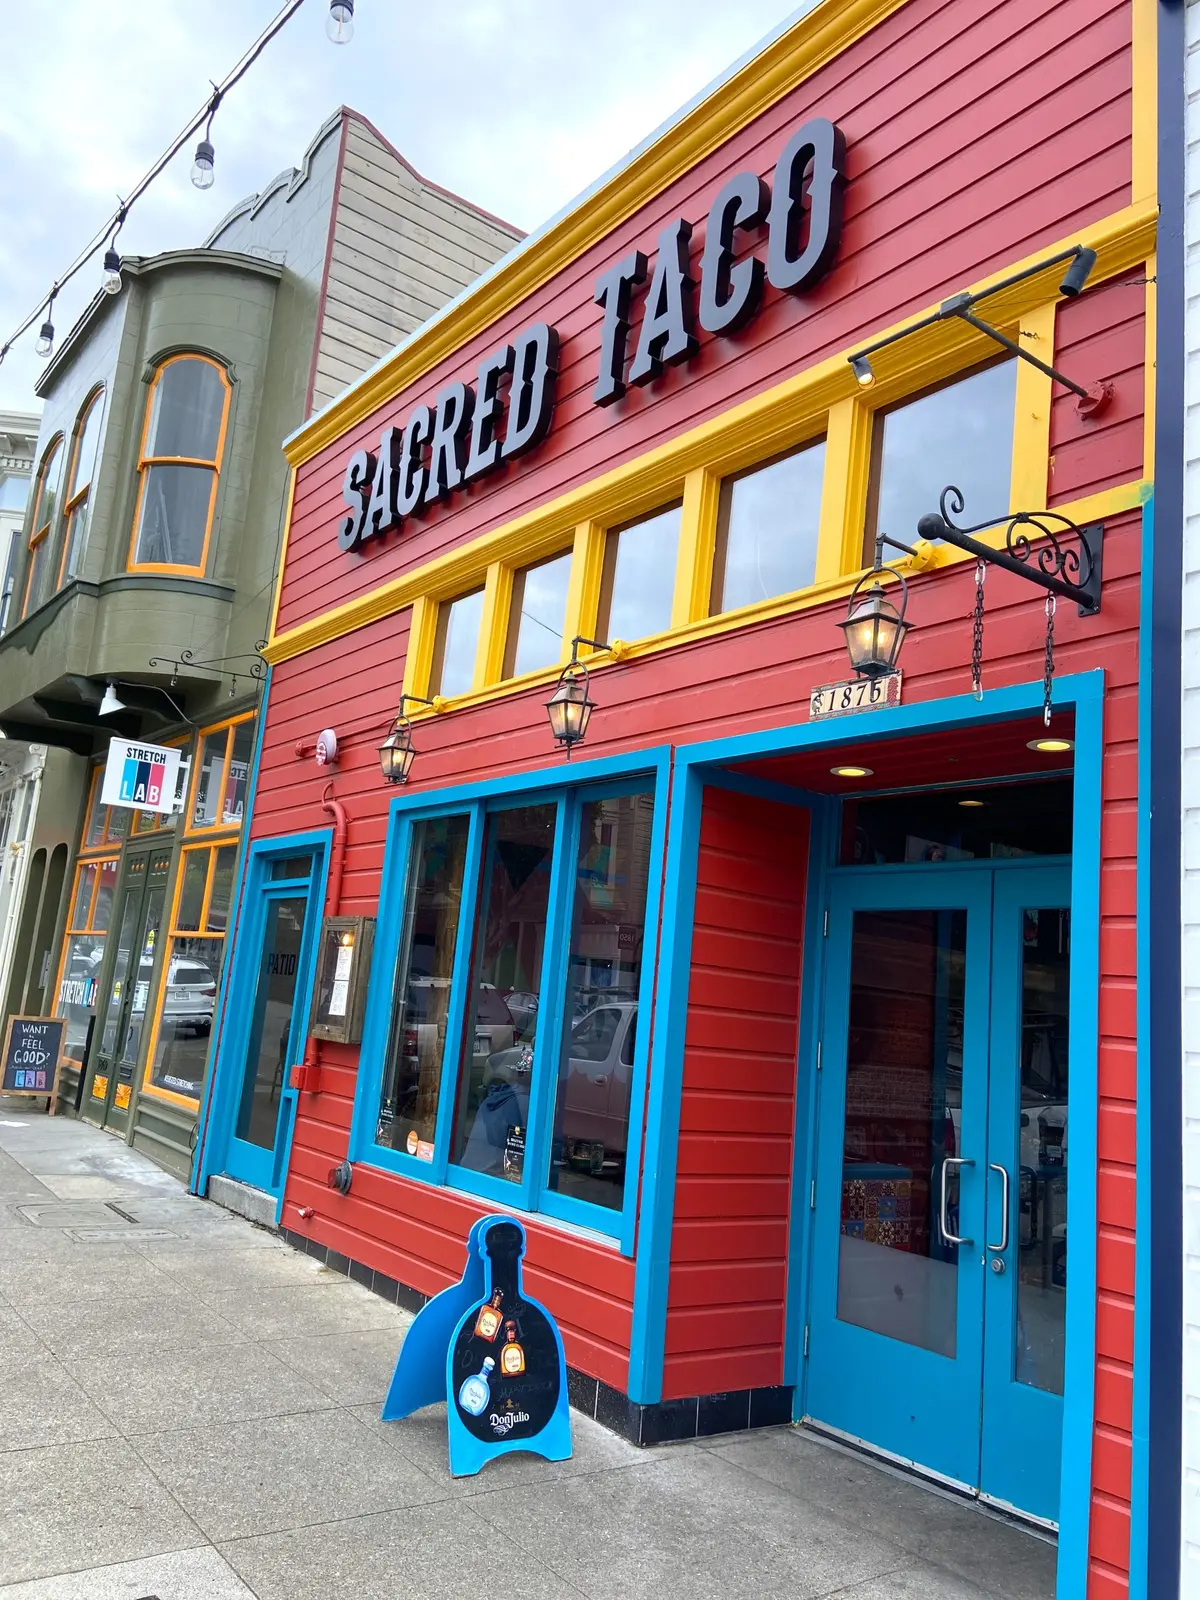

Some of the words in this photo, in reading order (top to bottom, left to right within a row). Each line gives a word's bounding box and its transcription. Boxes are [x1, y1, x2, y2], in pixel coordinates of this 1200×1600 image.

[338, 322, 560, 553] SACRED
[593, 117, 848, 408] TACO
[126, 747, 167, 765] STRETCH
[121, 780, 160, 803] LAB
[266, 953, 297, 976] PATIO
[21, 1023, 49, 1034] WANT
[21, 1038, 45, 1051] FEEL
[13, 1049, 51, 1065] GOOD?
